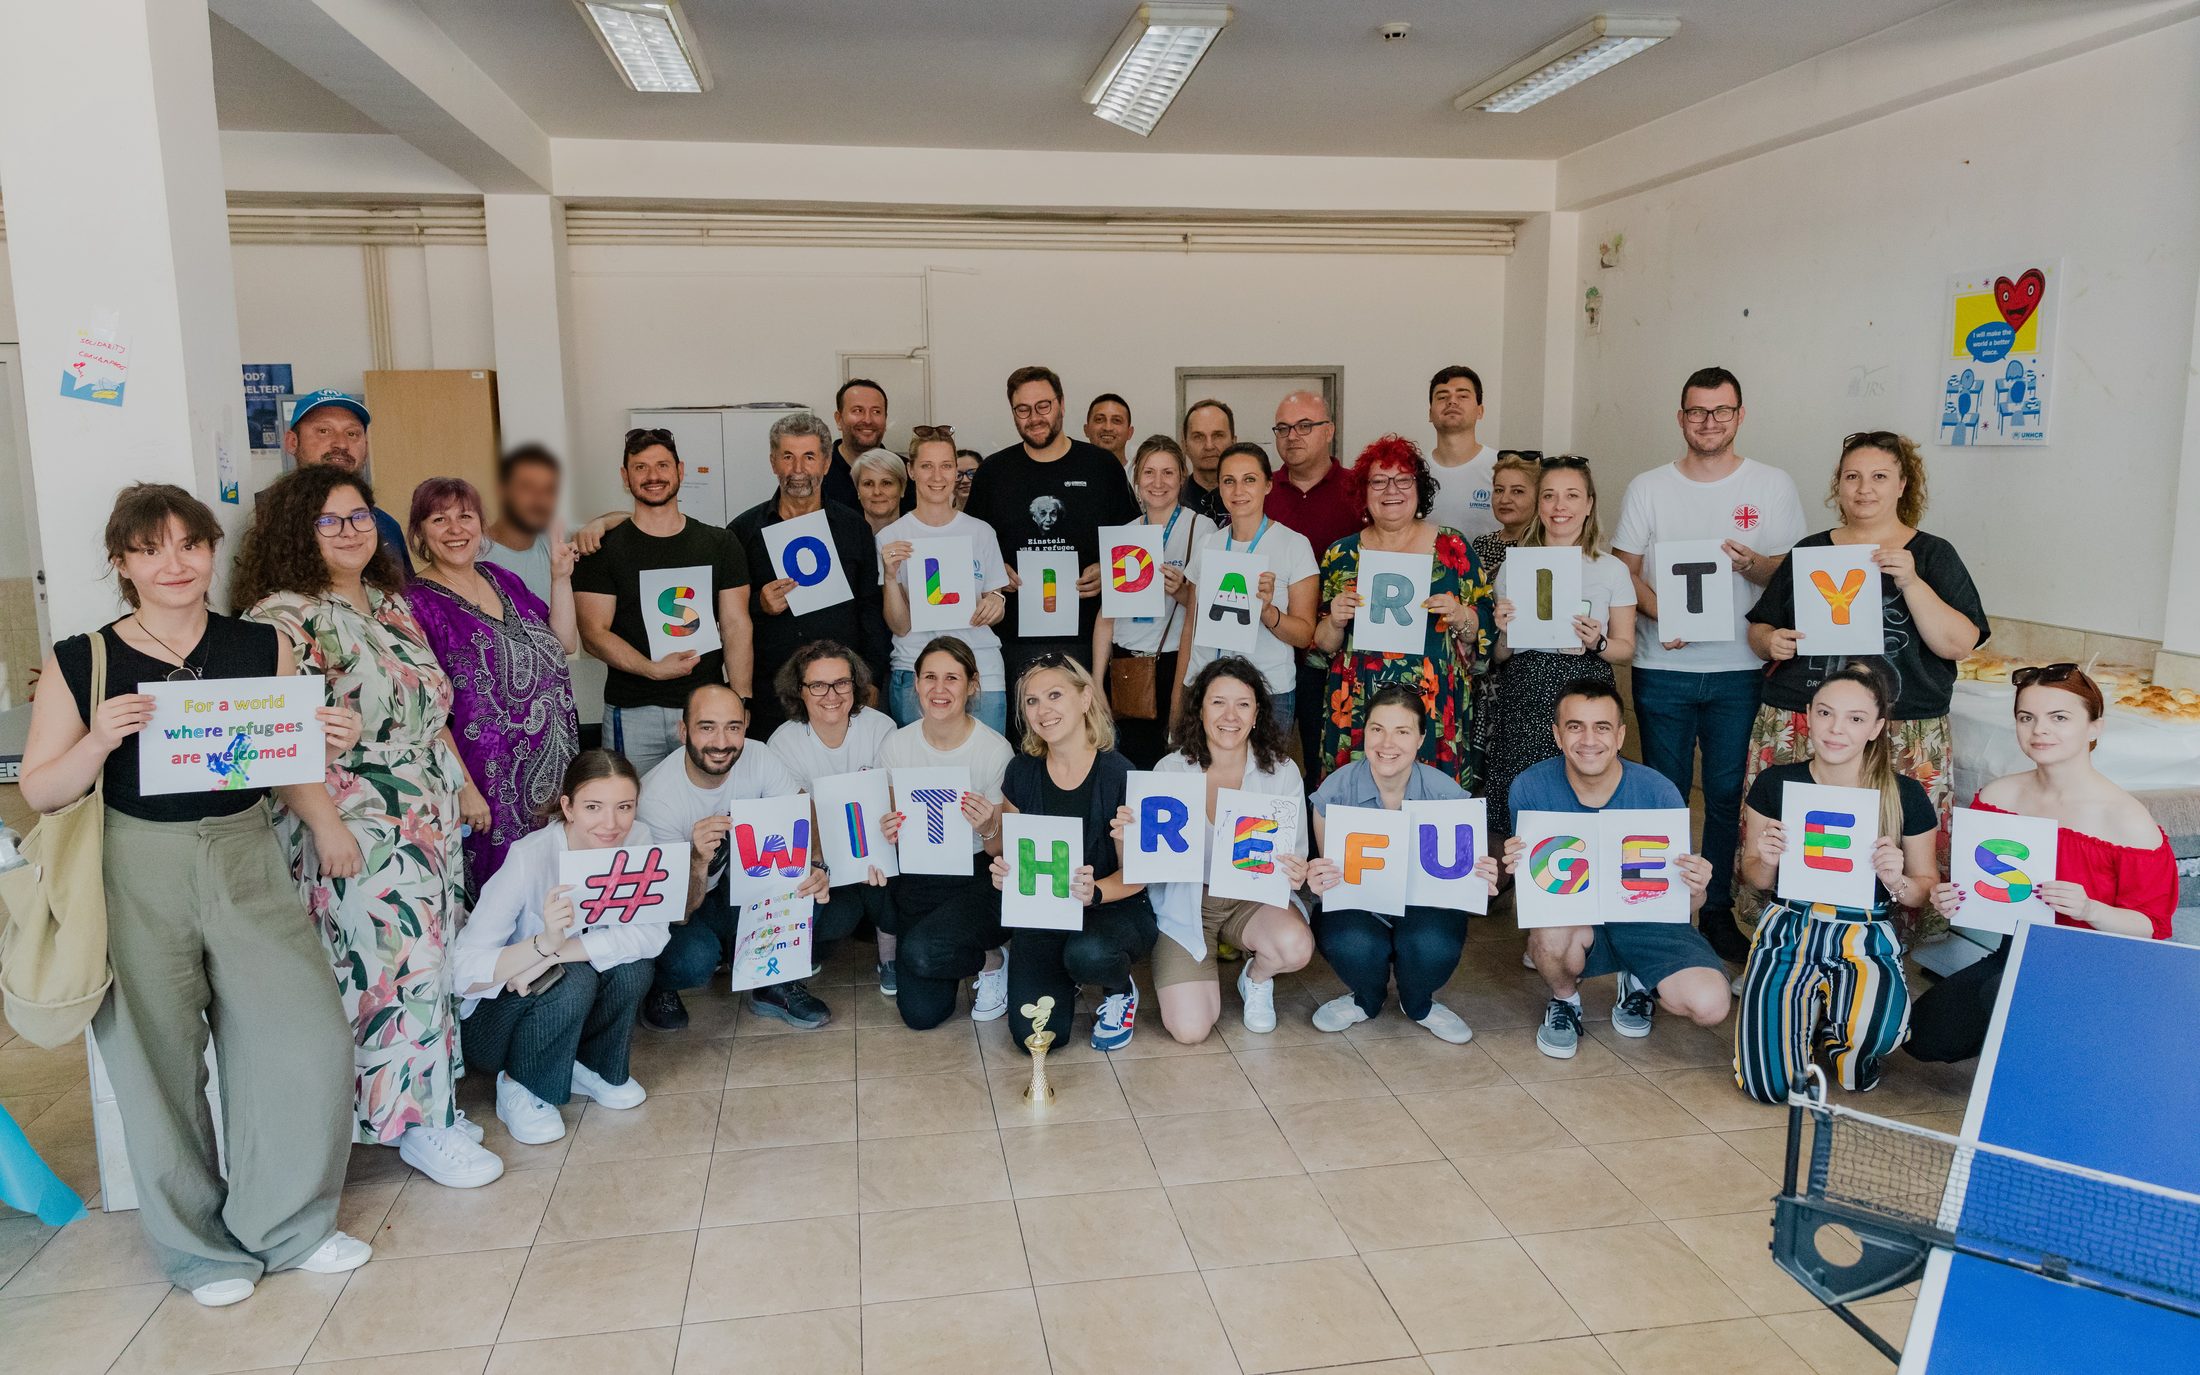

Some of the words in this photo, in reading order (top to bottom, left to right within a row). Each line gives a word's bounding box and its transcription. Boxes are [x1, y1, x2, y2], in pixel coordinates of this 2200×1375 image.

[244, 372, 266, 381] OD?
[244, 385, 286, 394] ELTER?
[782, 535, 832, 587] O
[1027, 537, 1066, 545] Einstein
[1042, 544, 1075, 552] refugee
[924, 557, 960, 606] L
[1042, 568, 1057, 613] I
[1111, 544, 1154, 593] D
[1536, 568, 1553, 621] I
[1671, 561, 1717, 614] T
[657, 586, 701, 637] S
[1208, 572, 1251, 626] A
[1369, 572, 1415, 626] R
[1808, 568, 1867, 625] Y
[164, 725, 223, 740] where
[228, 719, 303, 738] refugees
[184, 698, 214, 714] For
[219, 700, 229, 713] a
[234, 694, 285, 711] world
[171, 752, 201, 765] are
[206, 744, 297, 765] welcomed
[845, 801, 868, 858] I
[911, 788, 957, 844] T
[1140, 795, 1189, 853] R
[1804, 810, 1856, 873] E
[734, 818, 809, 877] W
[1018, 837, 1070, 898] H
[1232, 815, 1279, 874] E
[1343, 831, 1390, 885] F
[1419, 823, 1474, 880] U
[1529, 835, 1589, 894] G
[1621, 835, 1670, 891] E
[1973, 838, 2033, 904] S
[788, 922, 806, 931] are
